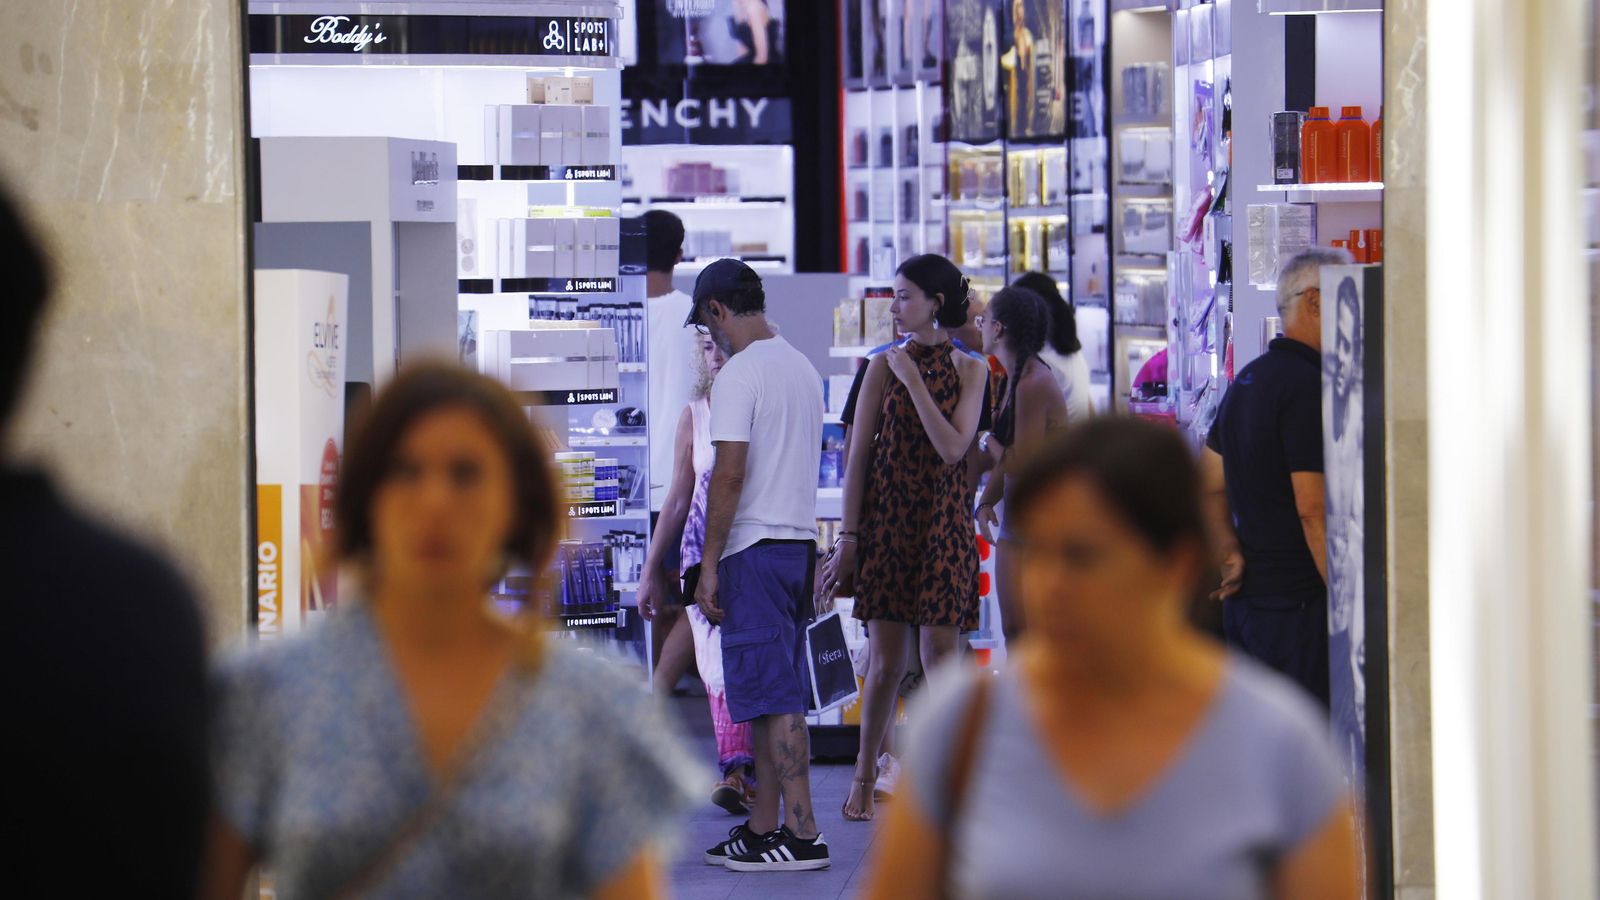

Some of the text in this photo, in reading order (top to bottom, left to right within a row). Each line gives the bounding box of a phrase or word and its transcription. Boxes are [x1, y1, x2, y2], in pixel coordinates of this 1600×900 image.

[303, 15, 387, 52] Boddy's
[574, 21, 604, 34] SPOTS
[574, 37, 604, 52] LAB+
[620, 97, 768, 129] ENCHY
